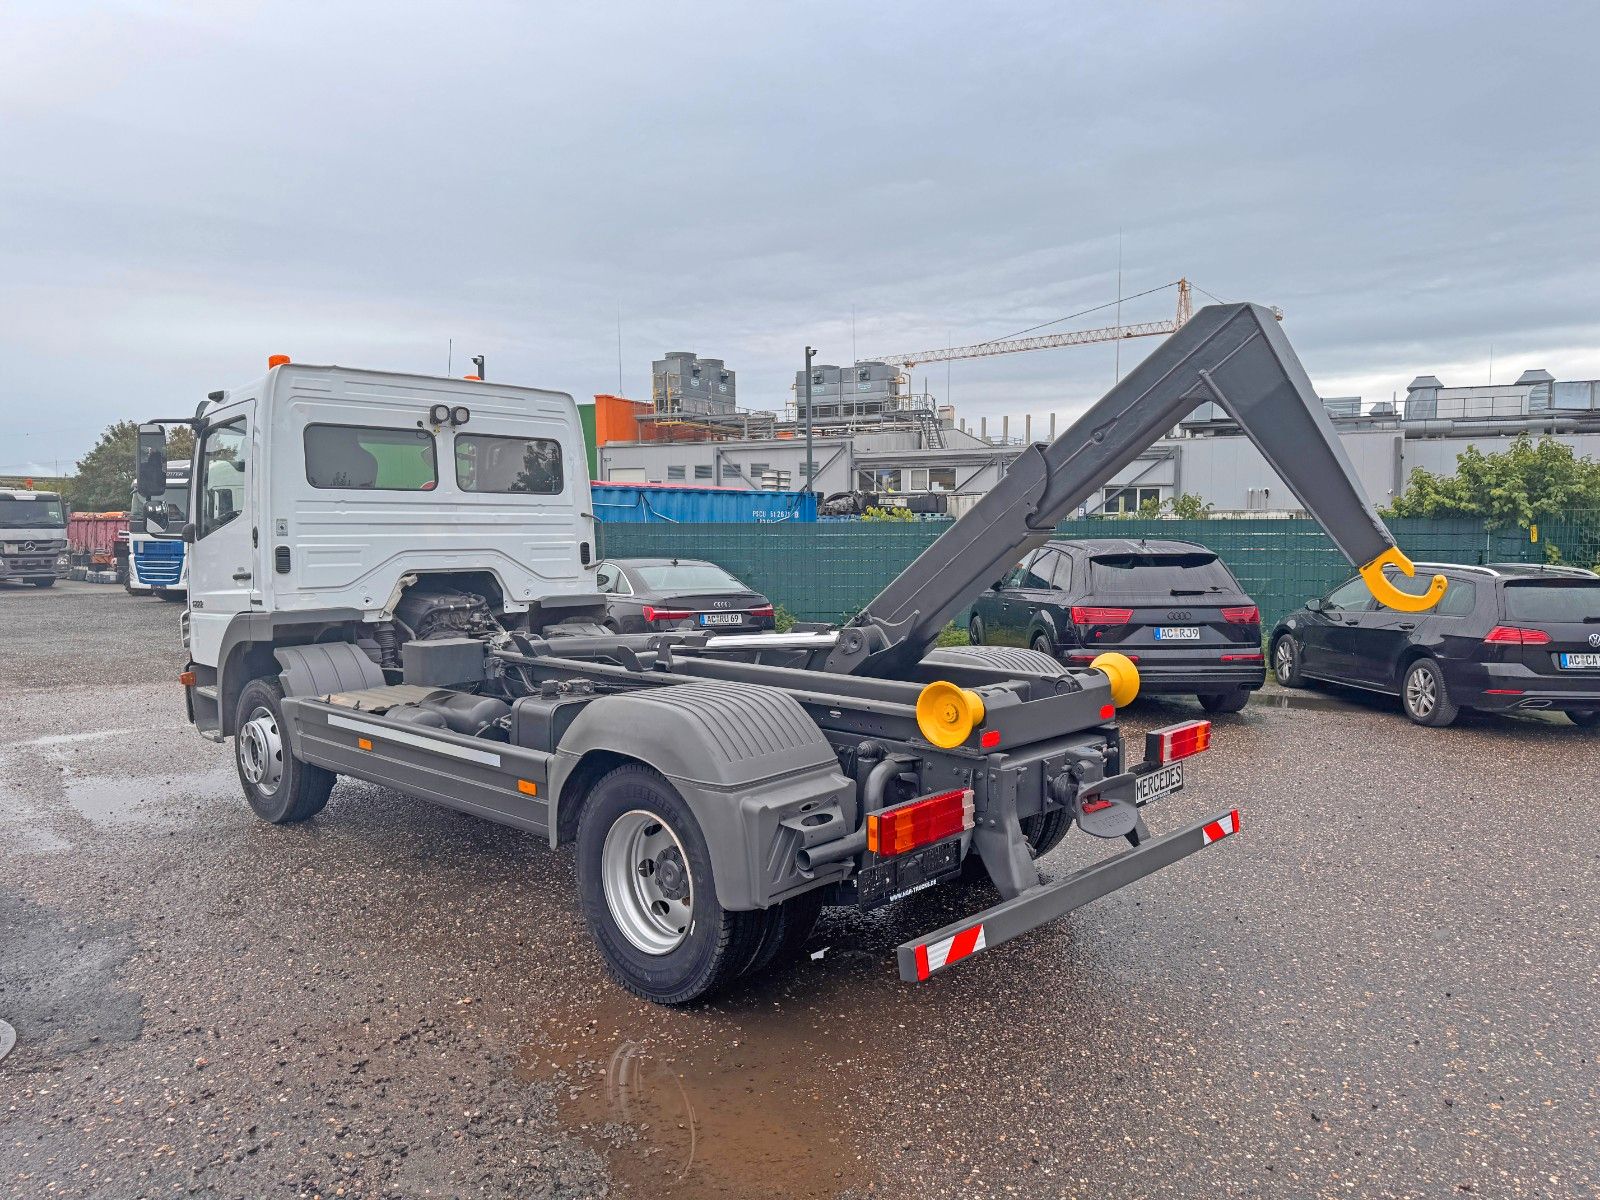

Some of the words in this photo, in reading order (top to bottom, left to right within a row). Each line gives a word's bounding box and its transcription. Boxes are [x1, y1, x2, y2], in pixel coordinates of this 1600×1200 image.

[707, 614, 716, 624] AC
[730, 614, 739, 623] 69
[1161, 628, 1173, 638] AC
[1568, 654, 1580, 666] AC
[1136, 765, 1182, 801] MERCEDES
